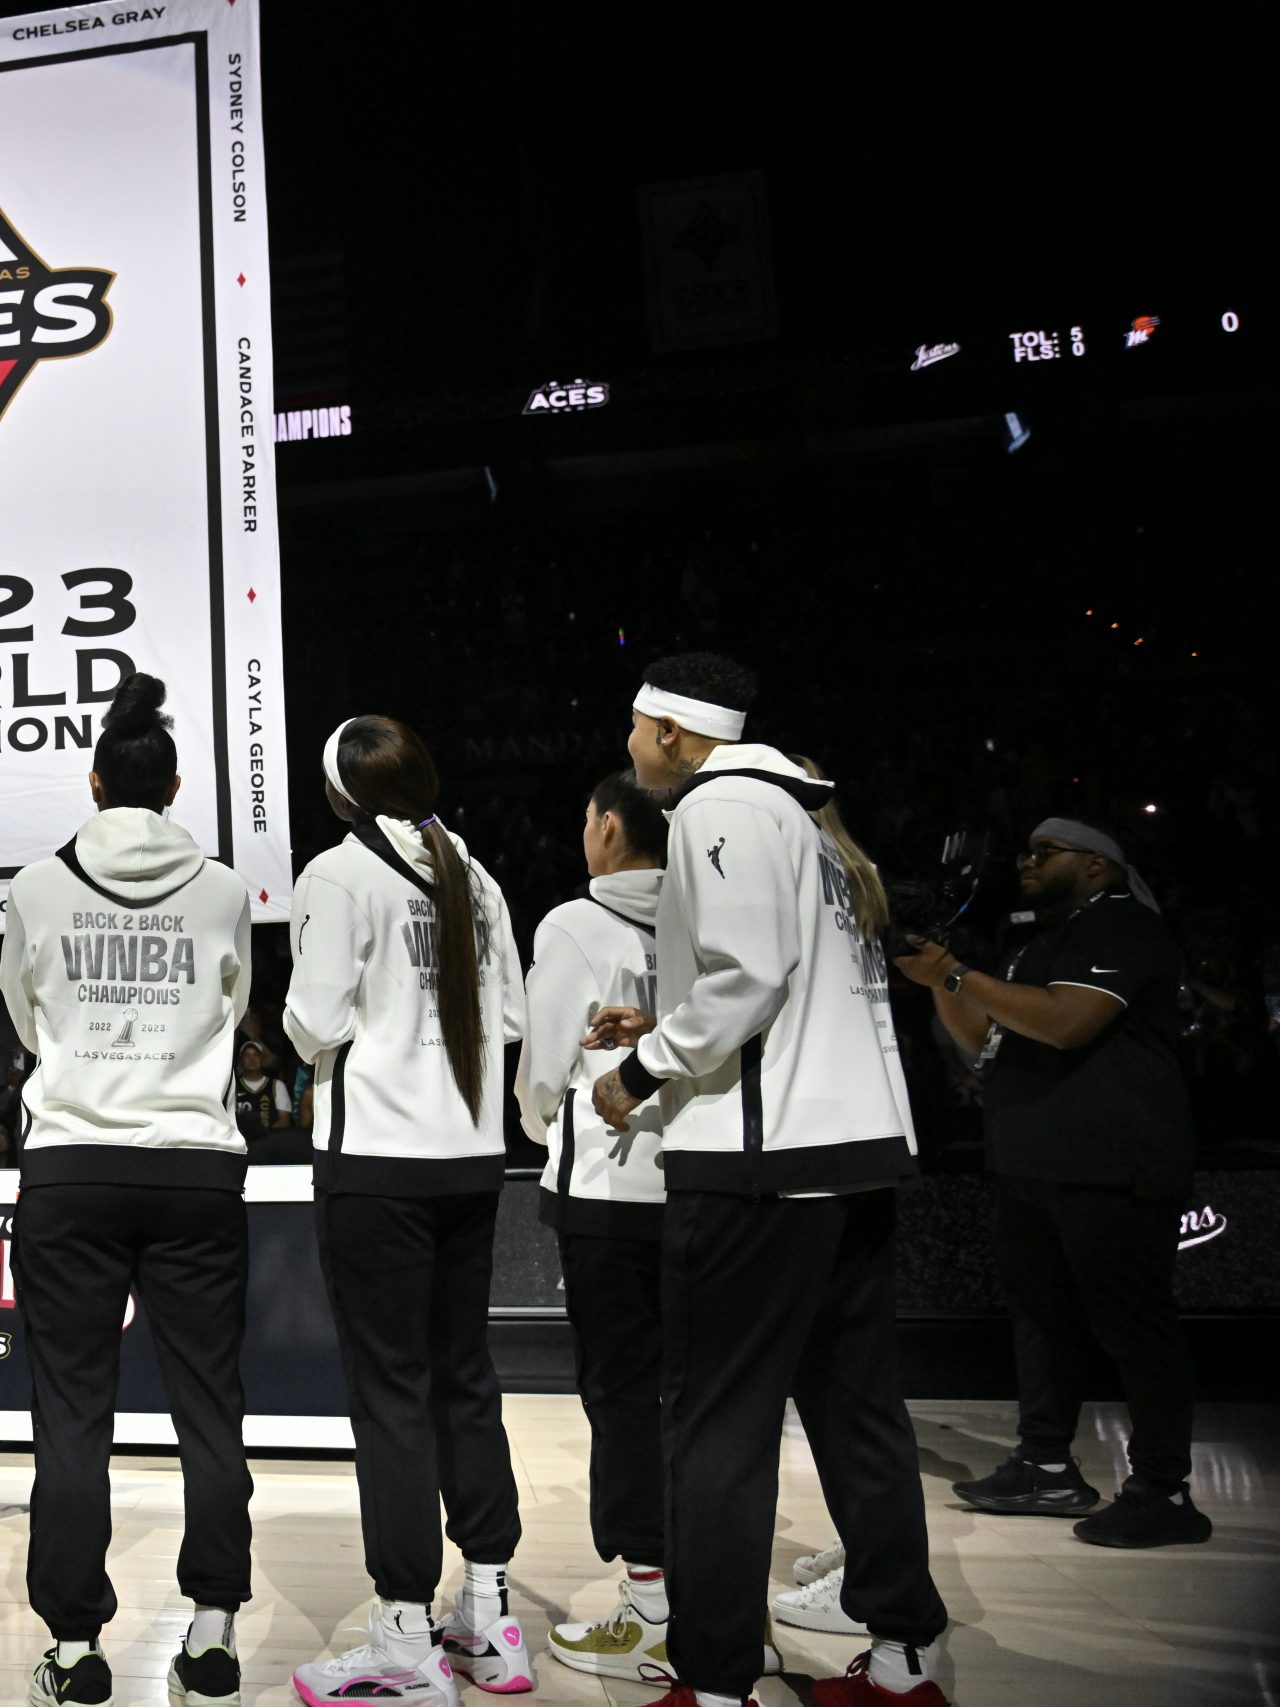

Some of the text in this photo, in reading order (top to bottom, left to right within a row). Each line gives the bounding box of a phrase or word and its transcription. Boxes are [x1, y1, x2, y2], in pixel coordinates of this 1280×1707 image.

[12, 6, 166, 42] CHELSEA GRAY
[228, 53, 246, 222] SYDNEY COLSON
[1221, 312, 1239, 332] 0
[1009, 326, 1083, 350] TOL: 5
[1013, 341, 1085, 362] FLS: 0
[529, 385, 606, 411] ACES
[237, 337, 257, 532] CANDACE PARKER
[247, 658, 267, 833] CAYLA GEORGE
[72, 912, 185, 933] BACK 2 BACK
[60, 933, 196, 985] WNBA
[77, 983, 181, 1005] CHAMPIONS
[89, 1021, 166, 1033] 2022 2023
[74, 1050, 176, 1061] LAS VEGAS ACES
